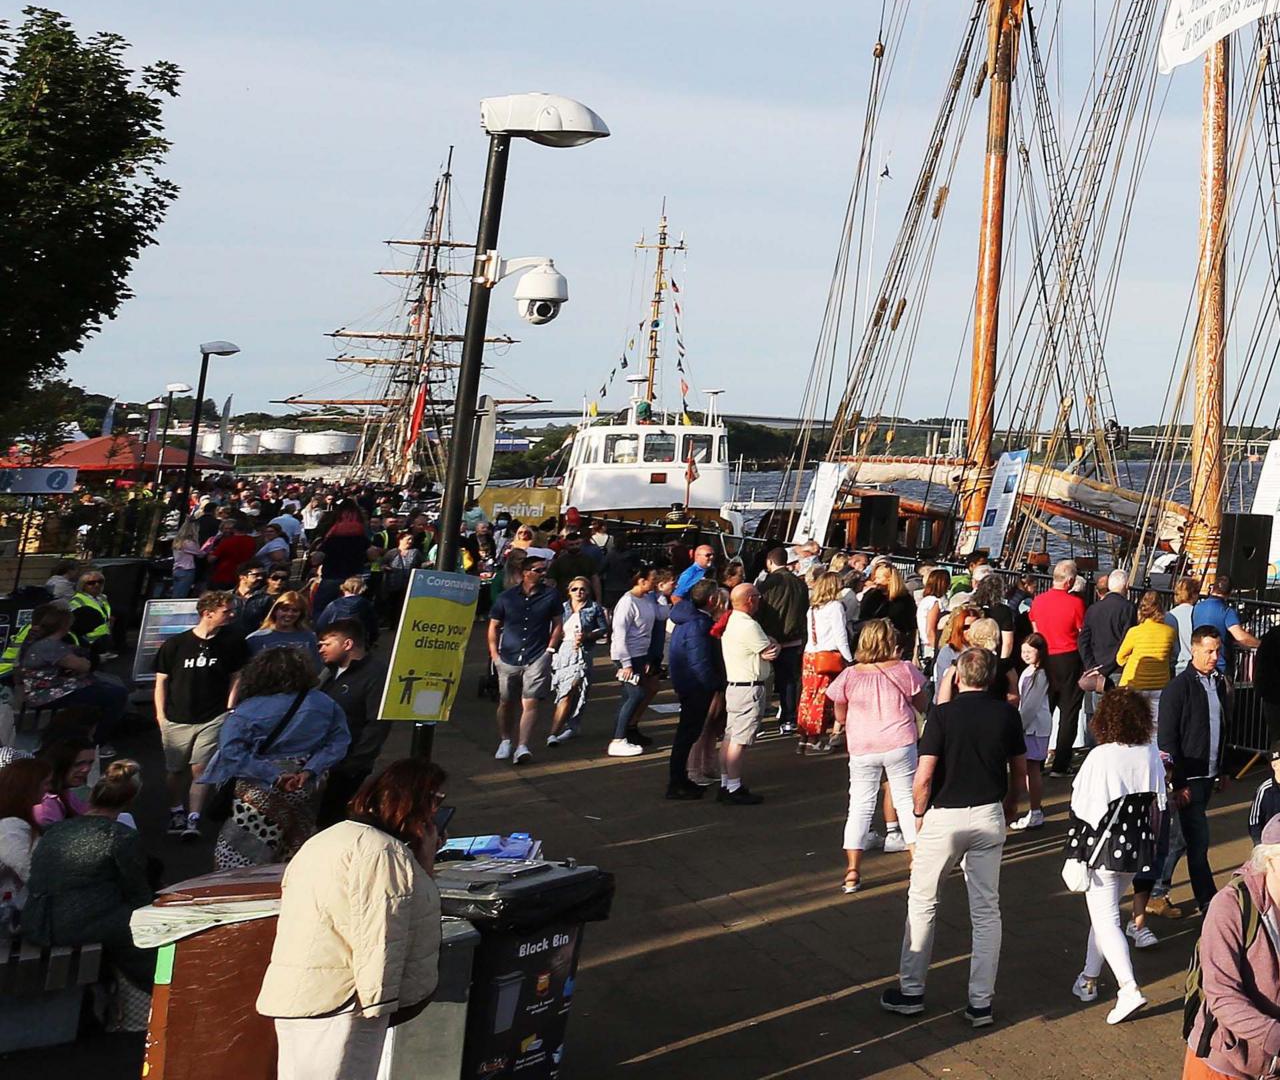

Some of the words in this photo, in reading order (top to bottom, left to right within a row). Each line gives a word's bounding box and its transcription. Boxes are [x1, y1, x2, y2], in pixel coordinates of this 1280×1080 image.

[493, 502, 545, 517] Festival
[412, 619, 445, 636] Keep
[447, 624, 467, 637] your
[414, 636, 460, 651] distance
[519, 938, 549, 957] Black
[552, 933, 569, 947] Bin
